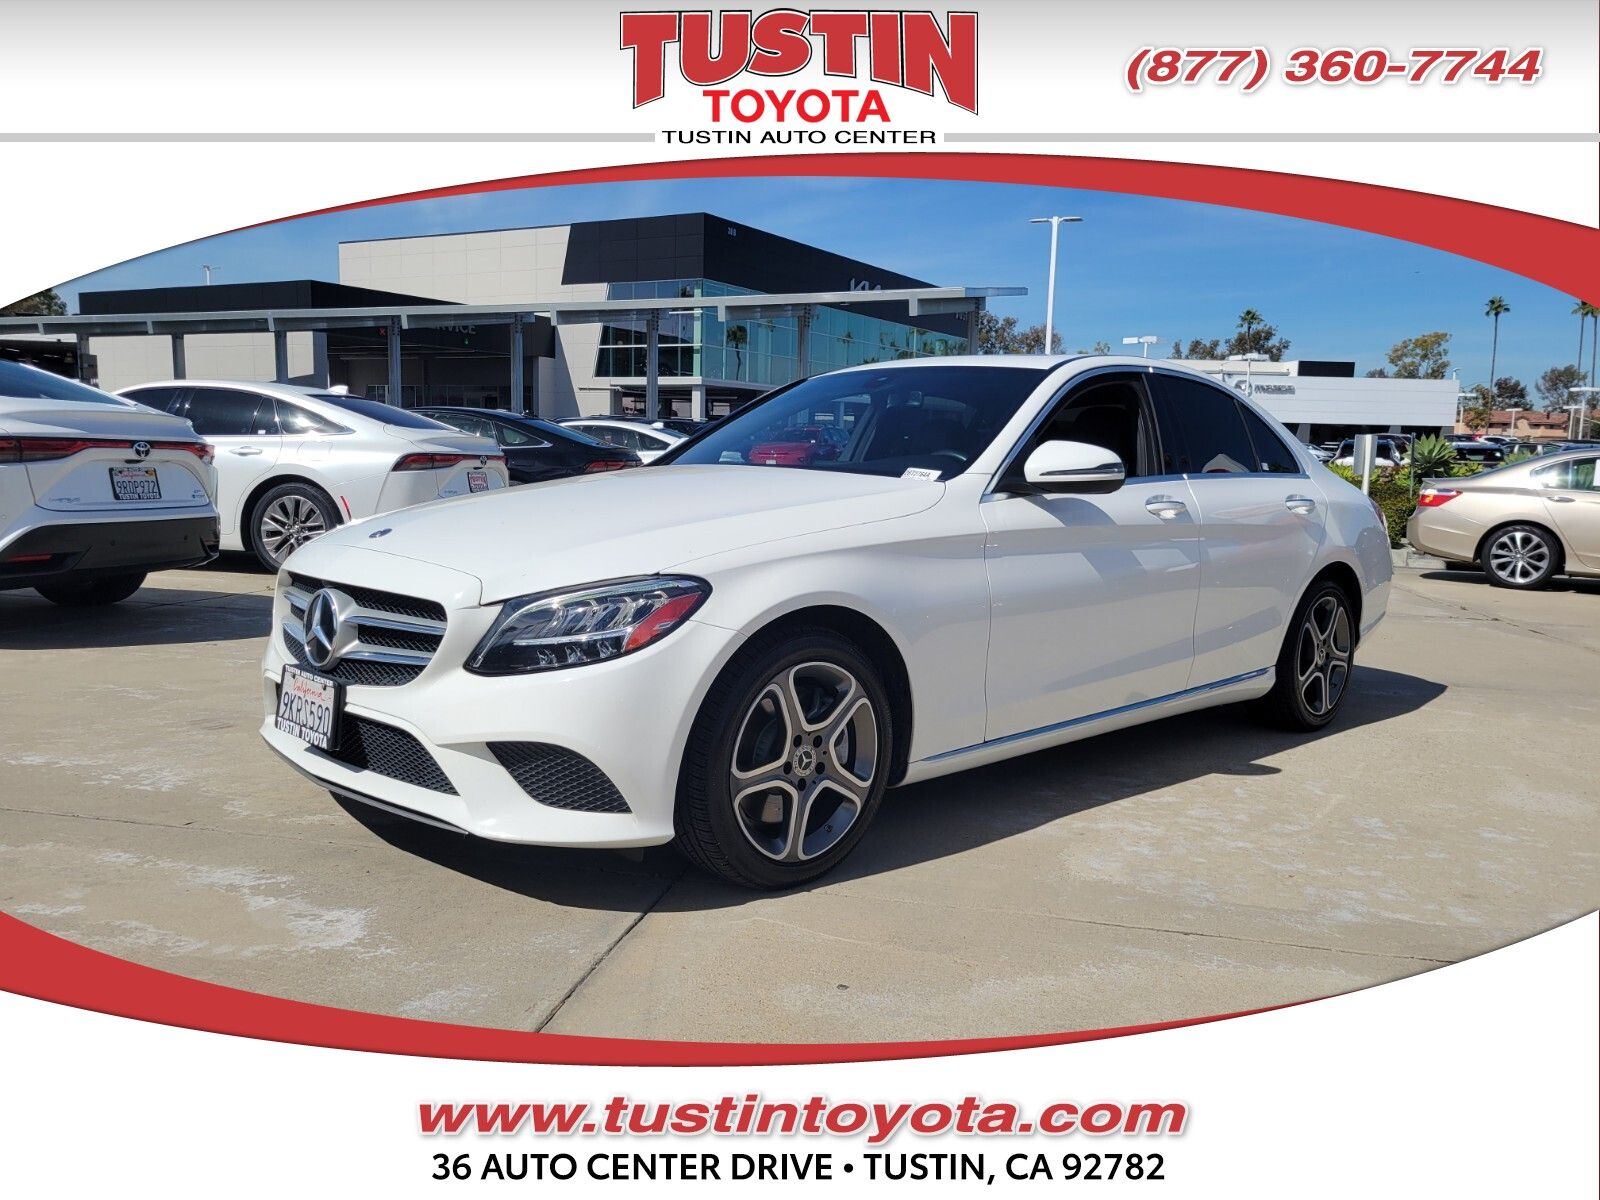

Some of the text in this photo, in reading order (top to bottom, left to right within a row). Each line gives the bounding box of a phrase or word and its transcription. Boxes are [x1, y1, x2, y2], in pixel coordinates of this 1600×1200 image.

[116, 481, 157, 494] 9RDP972
[285, 665, 334, 687] TUSTIN AUTO CENTER
[281, 691, 331, 735] 9KRS590
[278, 717, 328, 750] TUSTIN TOYOTA
